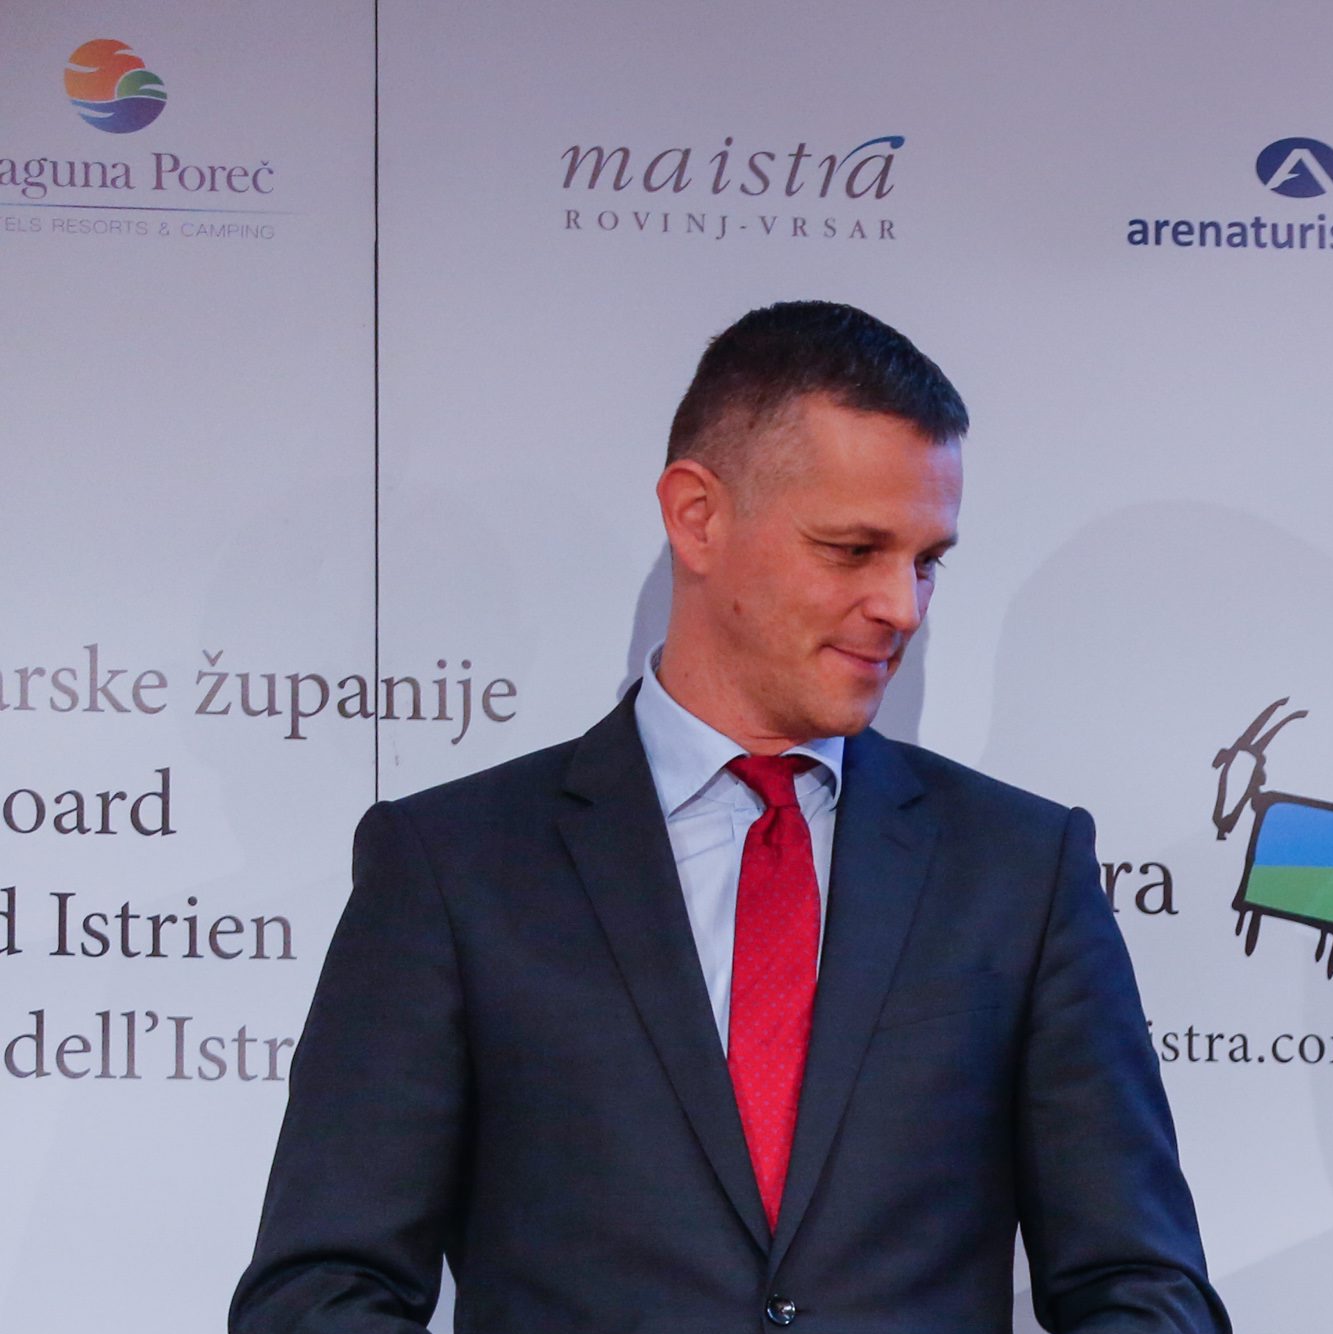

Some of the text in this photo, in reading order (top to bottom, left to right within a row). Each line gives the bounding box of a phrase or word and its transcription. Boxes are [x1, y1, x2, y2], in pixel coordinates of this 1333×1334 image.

[0, 152, 275, 200] aguna Poreč
[561, 135, 905, 200] maistra
[0, 217, 275, 240] ELS RESORTS & CAMPING
[564, 208, 897, 240] ROVINJ-VRSAR
[0, 643, 518, 745] rske županije
[2, 767, 177, 836] oard
[49, 892, 298, 961] Istrien
